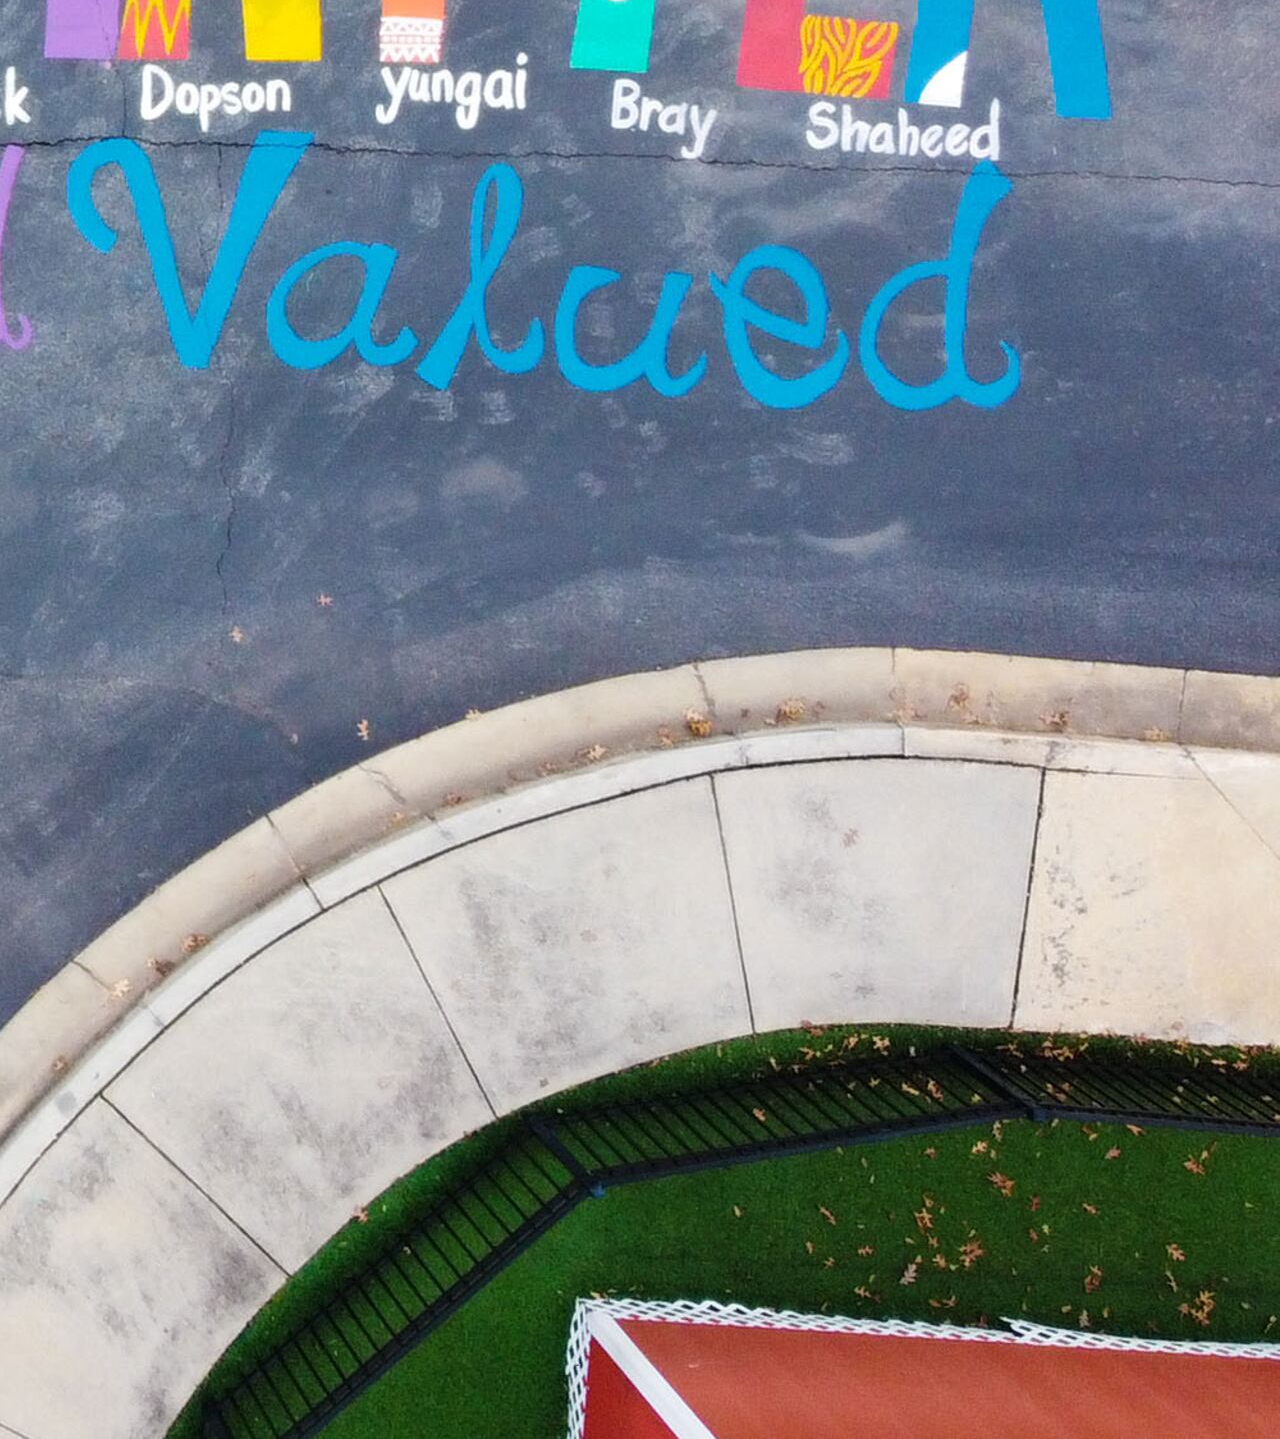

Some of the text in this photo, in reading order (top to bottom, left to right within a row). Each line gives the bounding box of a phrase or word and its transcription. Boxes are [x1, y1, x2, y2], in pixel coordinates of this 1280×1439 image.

[141, 65, 290, 132] Dopson
[612, 79, 717, 159] Bray
[806, 96, 999, 160] Shaheed
[65, 128, 1023, 415] Valued
